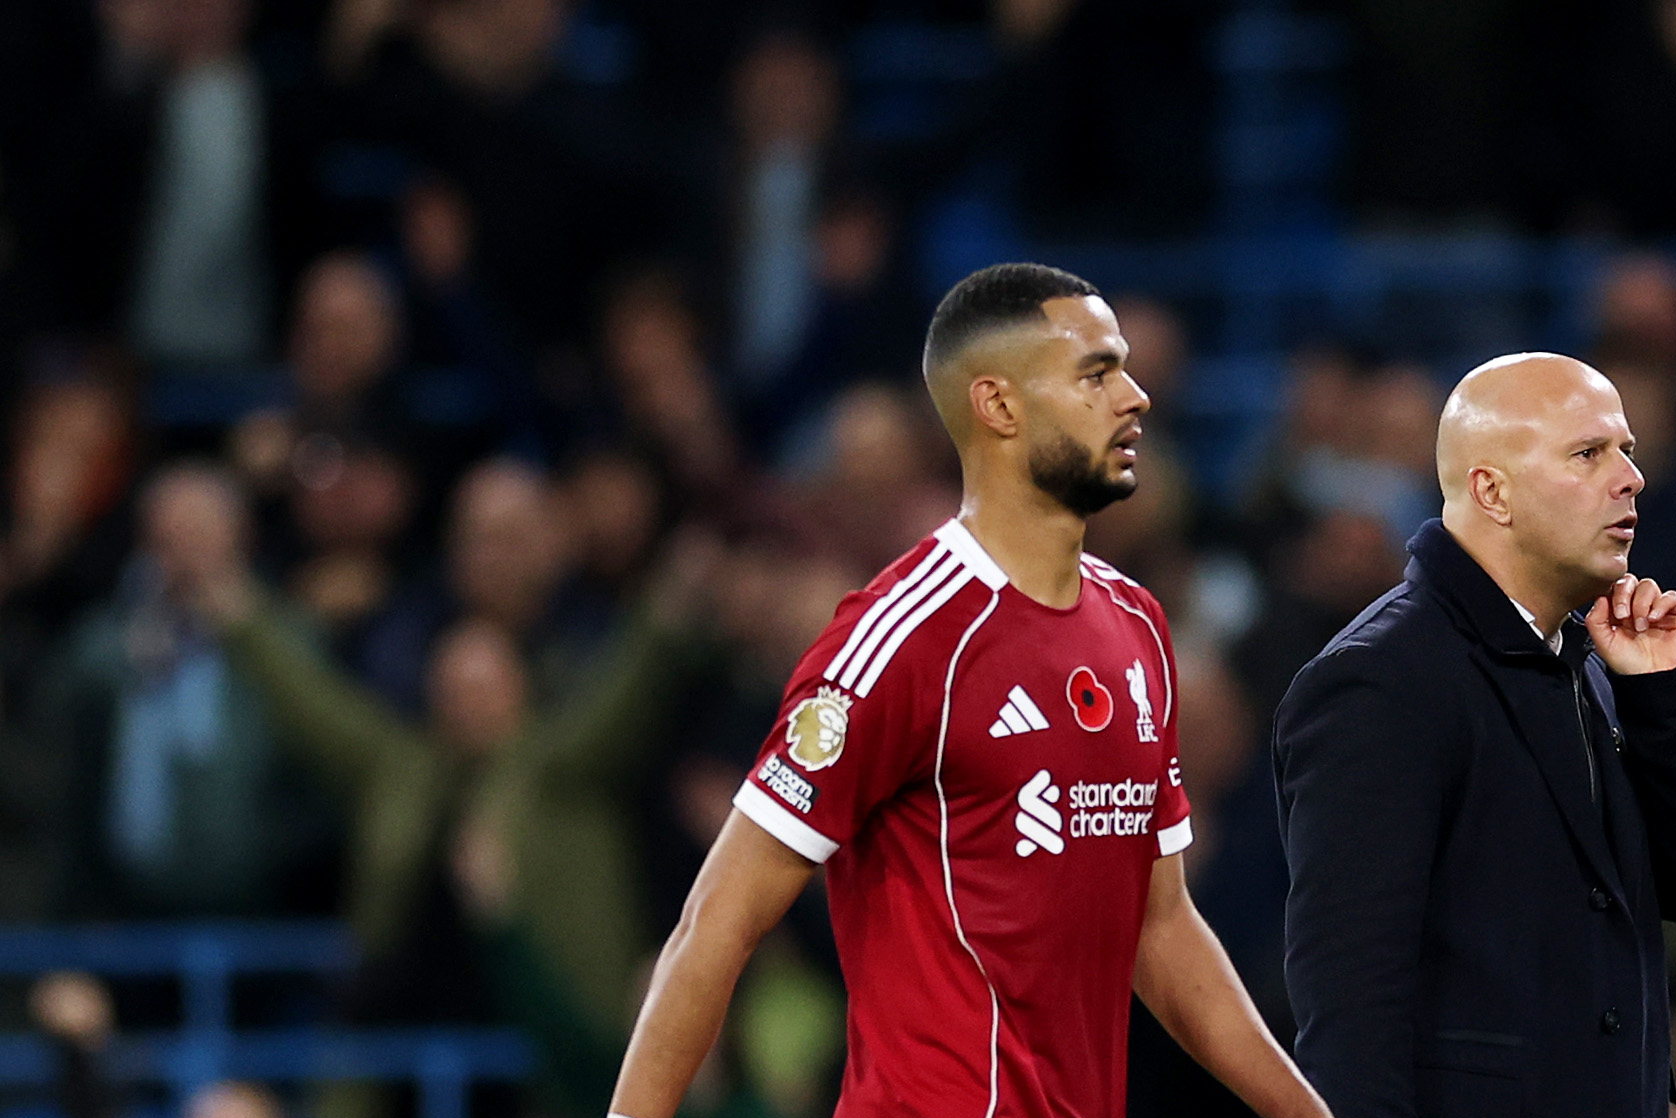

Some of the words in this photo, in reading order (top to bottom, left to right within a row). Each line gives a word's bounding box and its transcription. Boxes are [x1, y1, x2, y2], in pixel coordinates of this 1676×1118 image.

[766, 775, 812, 815] racism
[776, 764, 814, 800] room
[1068, 776, 1159, 809] standard
